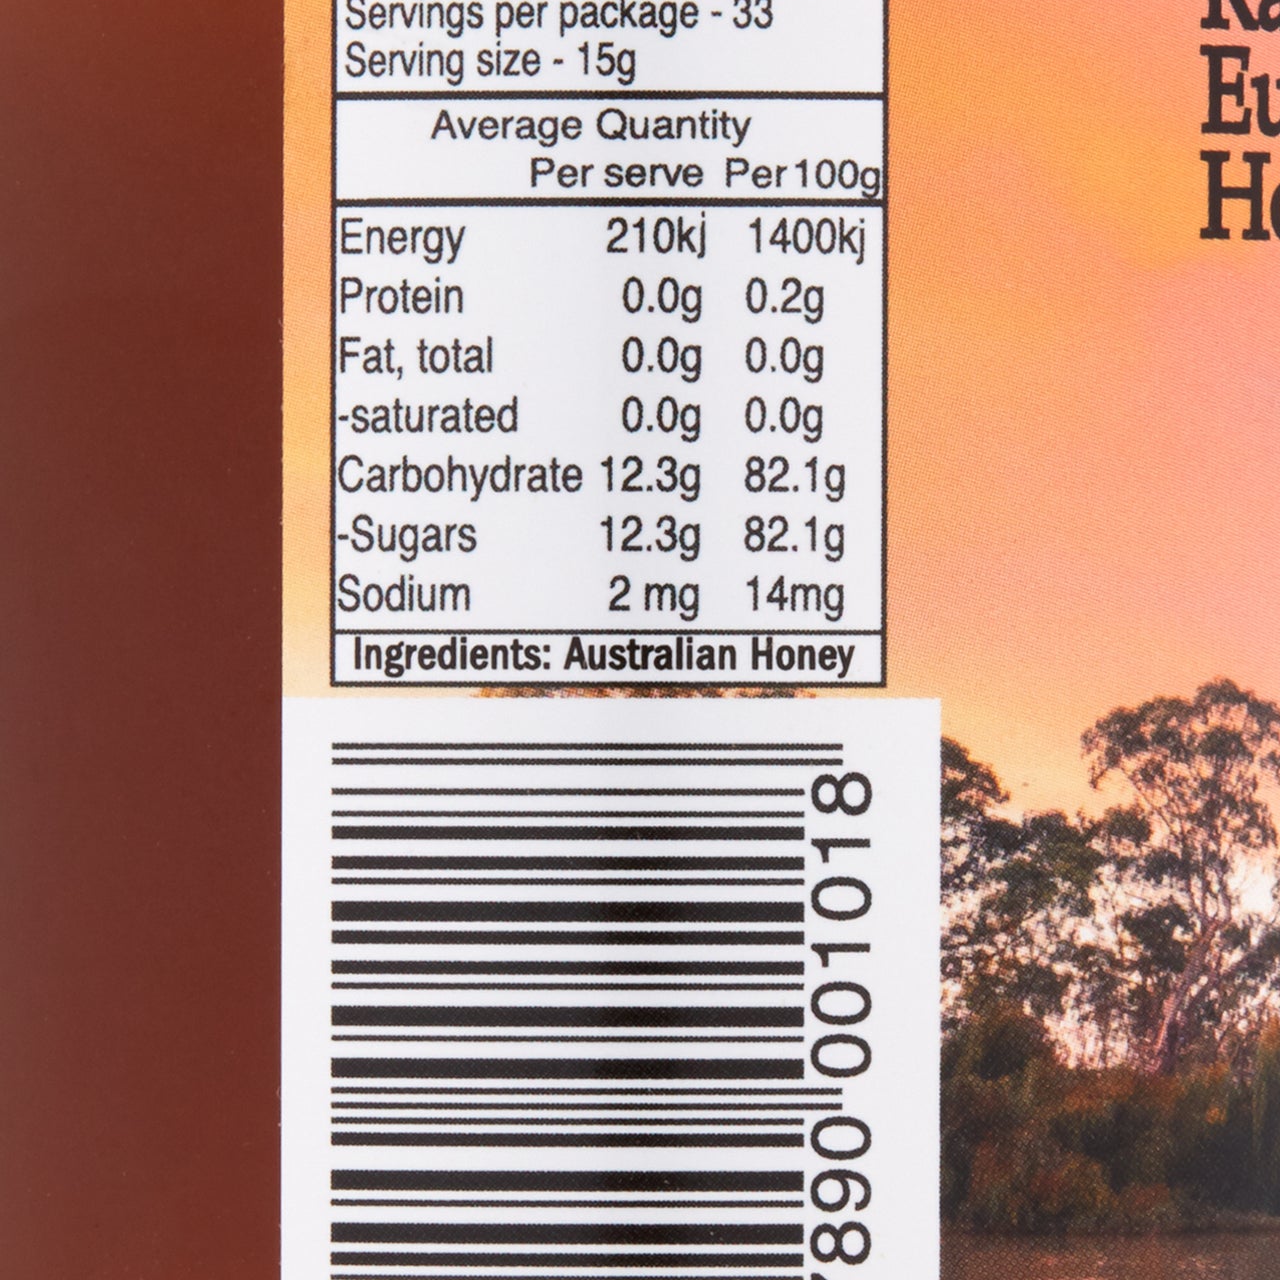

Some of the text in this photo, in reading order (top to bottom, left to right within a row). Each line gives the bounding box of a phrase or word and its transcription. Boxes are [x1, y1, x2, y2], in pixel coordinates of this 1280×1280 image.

[495, 1, 548, 38] per
[345, 41, 464, 86] Serving
[477, 40, 541, 77] size
[578, 41, 636, 86] 15g
[431, 108, 751, 148] Average Quantity
[531, 157, 704, 188] Per serve
[726, 157, 788, 189] Per
[341, 217, 466, 264] Energy
[606, 211, 706, 259] 210kj
[749, 217, 865, 265] 1400kj
[340, 276, 463, 314] Protein
[622, 276, 702, 324] 0.0g
[745, 277, 824, 325] 0.2g
[340, 336, 493, 380] Fat, total
[622, 336, 702, 383] 0.0g
[745, 336, 824, 384] 0.0g
[338, 395, 518, 434] -saturated
[622, 395, 701, 443] 0.0g
[745, 396, 823, 444] 0.0g
[338, 454, 583, 502] Carbohydrate
[601, 455, 701, 503] 12.3g
[744, 455, 845, 503] 82.1g
[337, 514, 477, 563] -Sugars
[600, 515, 701, 562] 12.3g
[744, 515, 844, 563] 82.1g
[337, 573, 470, 612] Sodium
[746, 575, 844, 622] 14mg
[354, 633, 855, 679] Ingredients: Australian Honey
